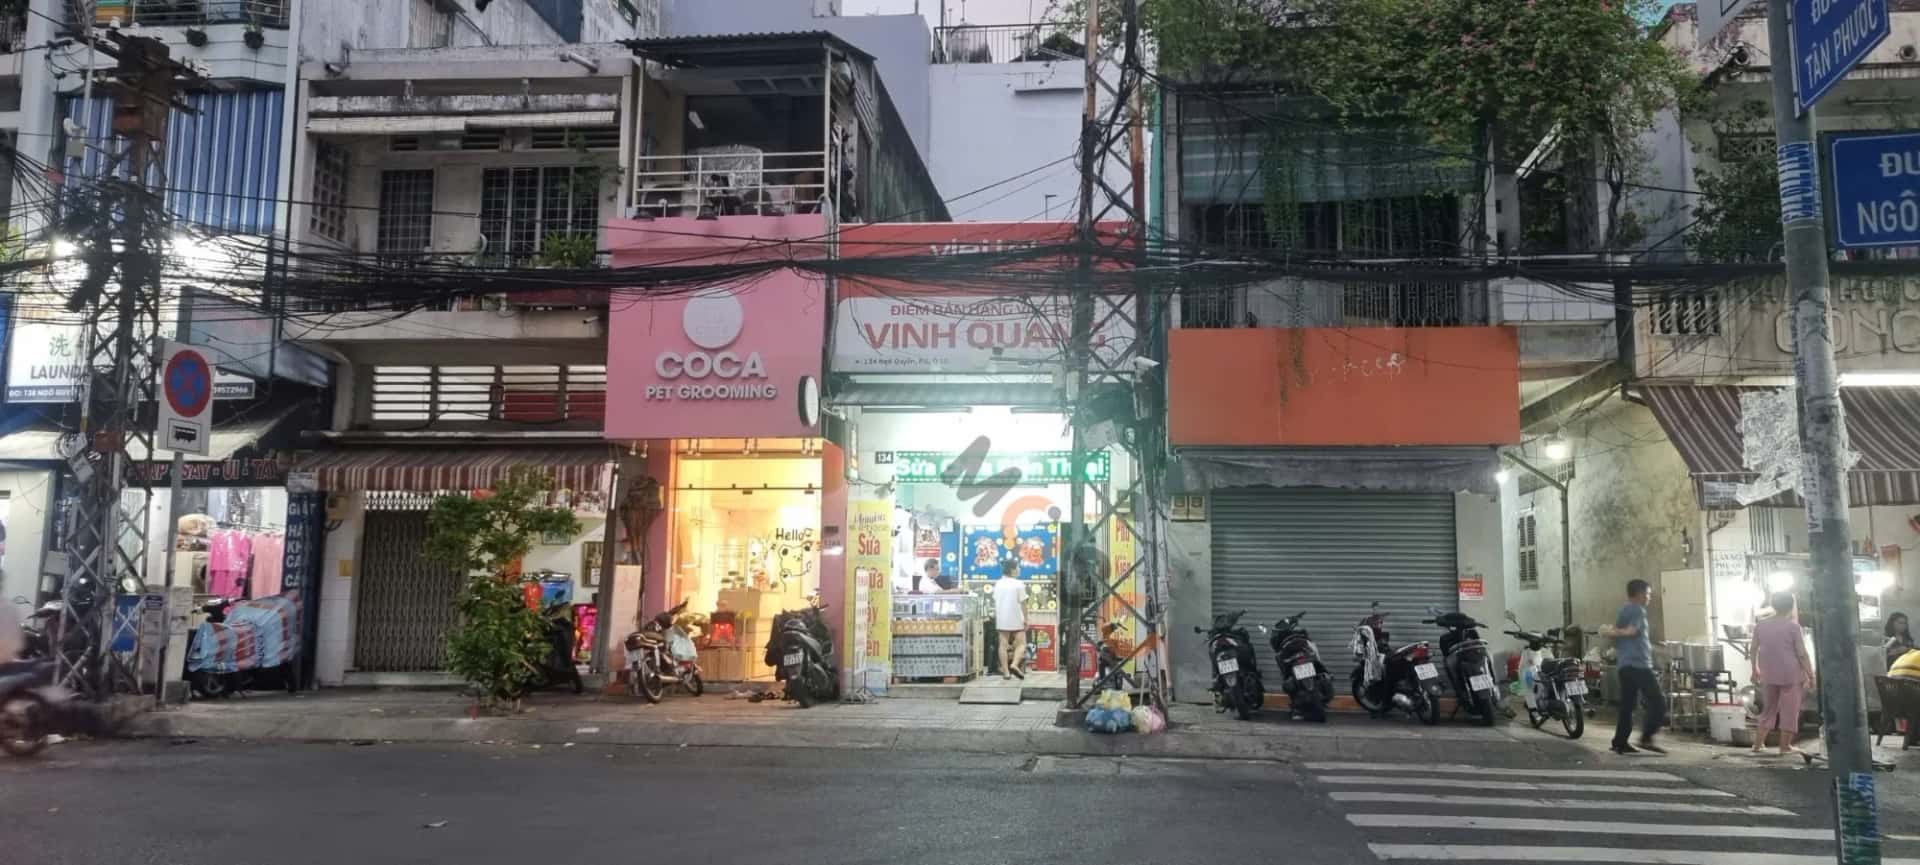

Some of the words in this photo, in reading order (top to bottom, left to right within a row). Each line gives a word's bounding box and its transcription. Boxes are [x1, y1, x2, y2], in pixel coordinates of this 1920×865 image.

[1857, 190, 1918, 235] NGÔ
[50, 333, 72, 357] 洗
[864, 322, 956, 350] VINH
[655, 350, 768, 379] COCA
[646, 385, 673, 400] PET
[678, 383, 777, 400] GROOMING
[776, 528, 805, 541] Hello
